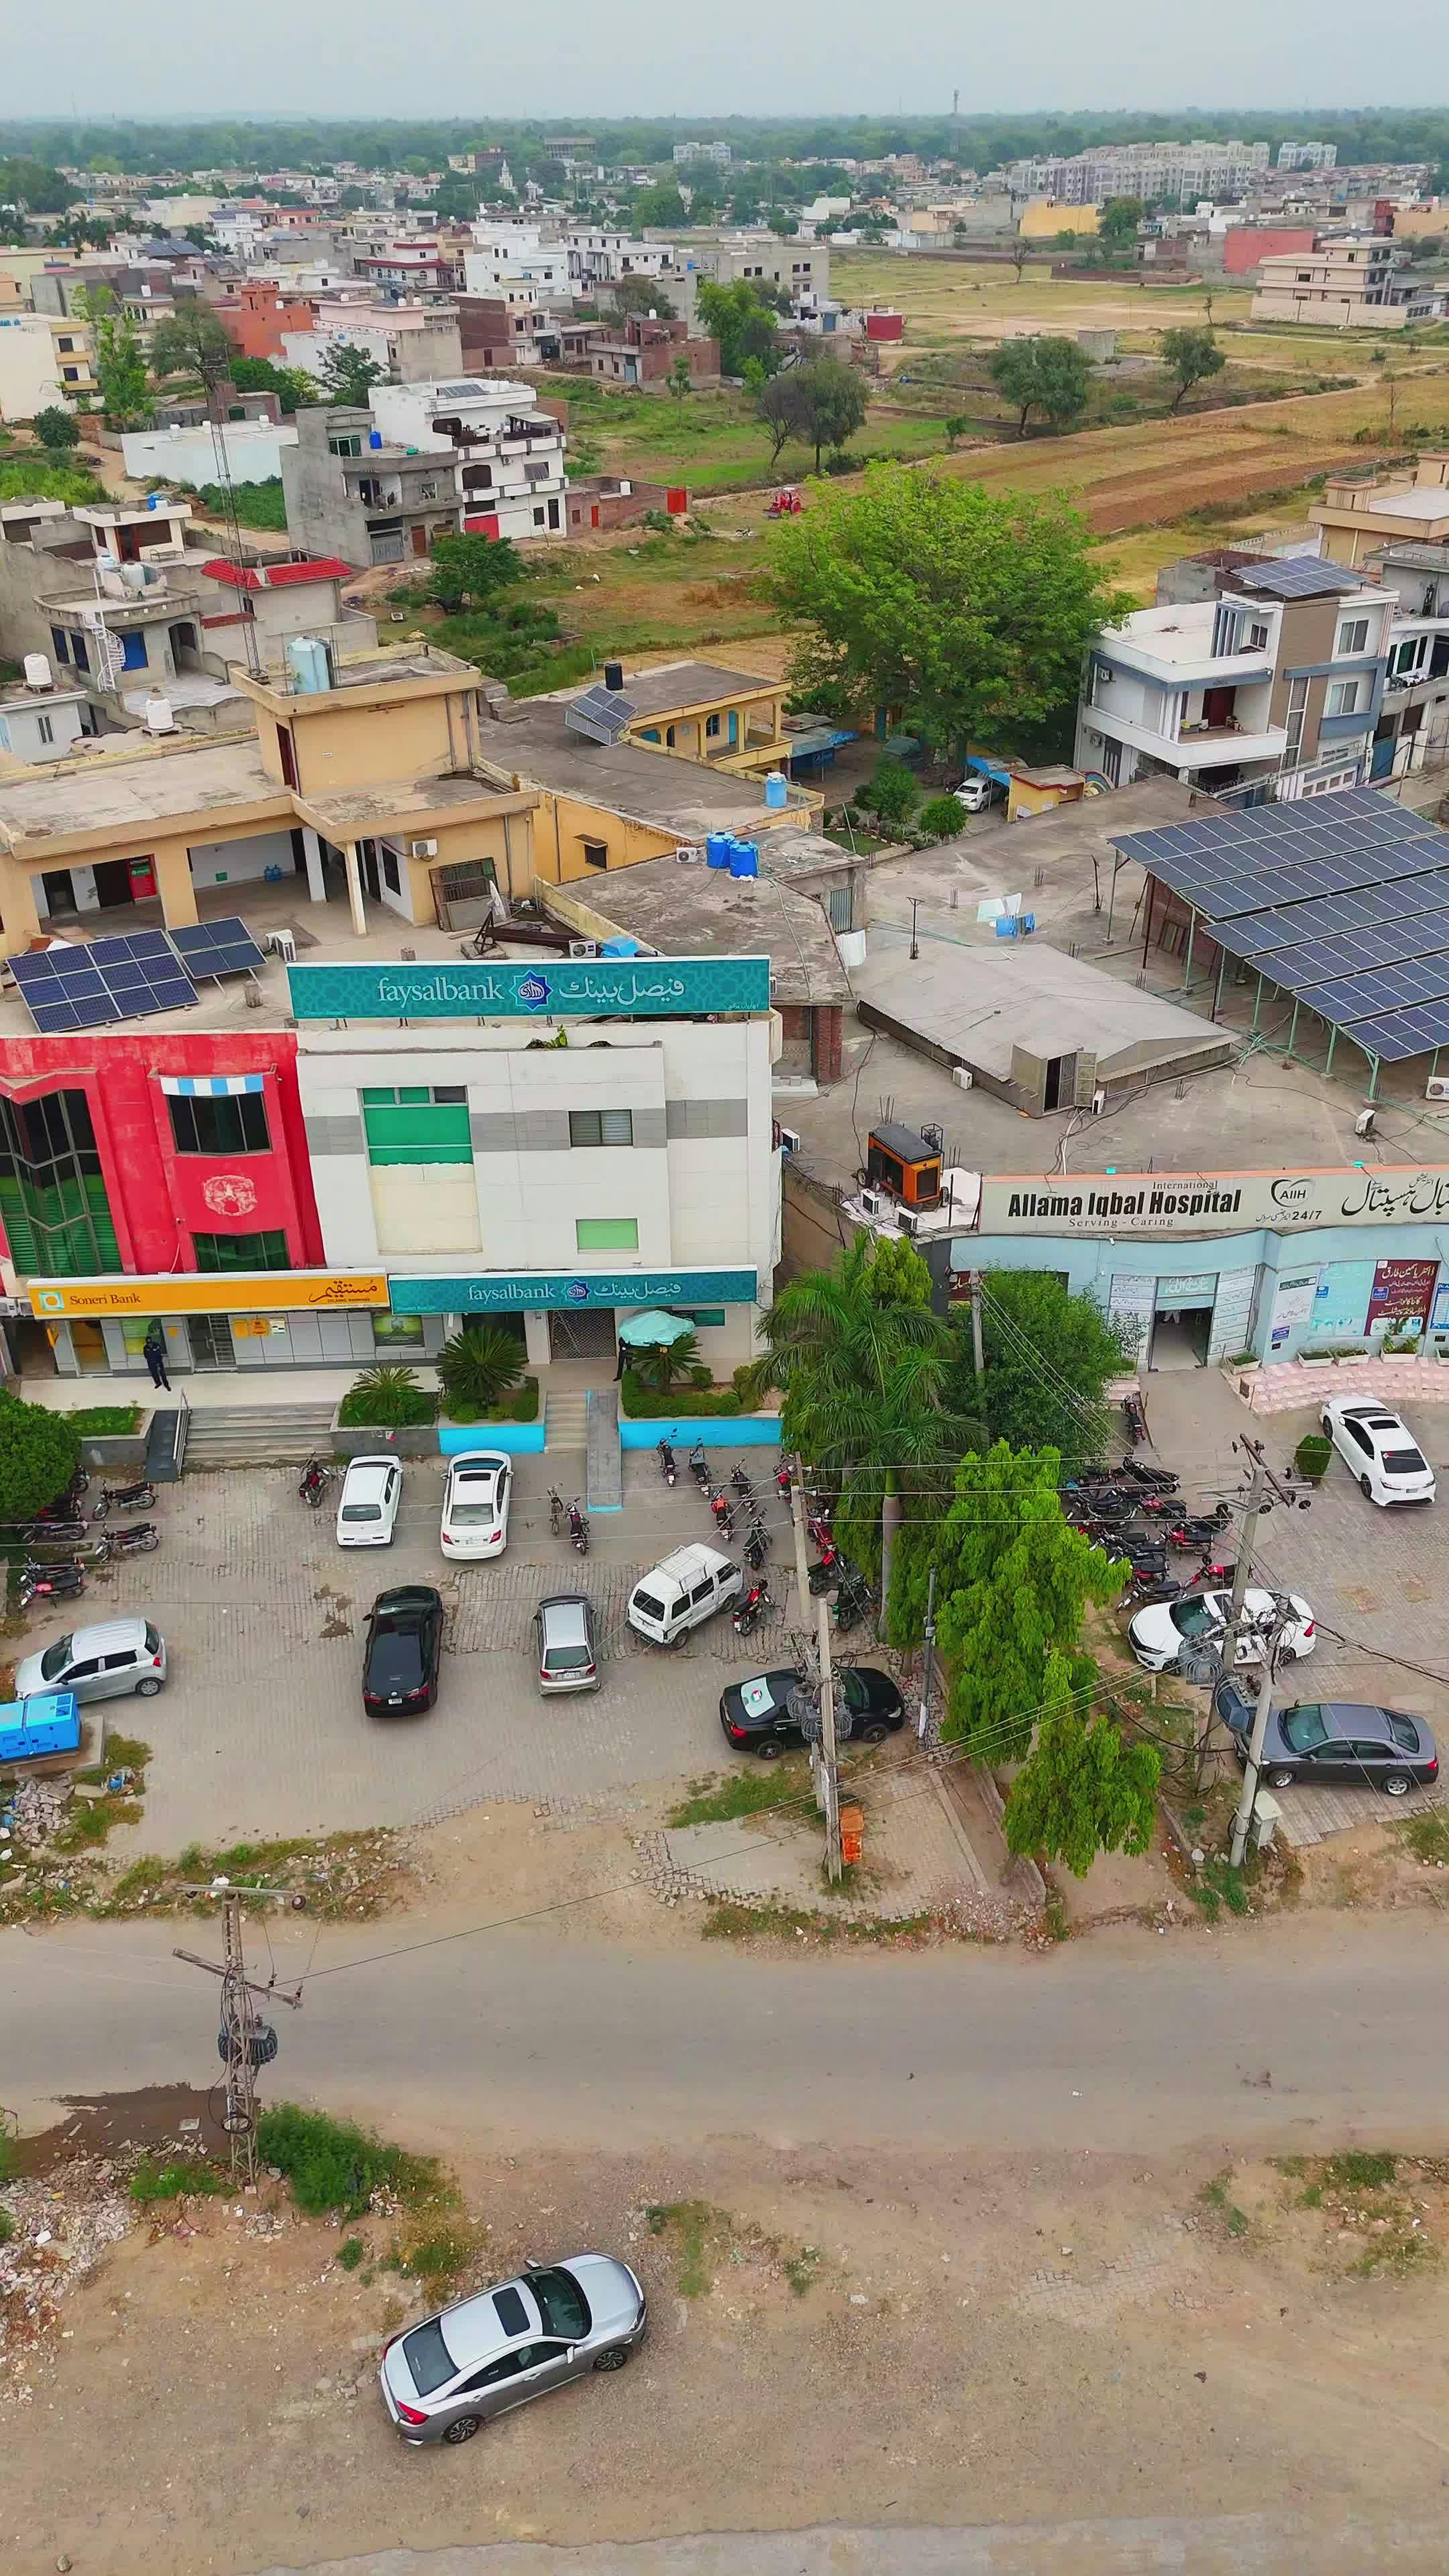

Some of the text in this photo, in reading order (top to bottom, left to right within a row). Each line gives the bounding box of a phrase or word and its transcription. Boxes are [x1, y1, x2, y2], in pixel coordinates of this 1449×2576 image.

[377, 977, 504, 1008] faysalbank
[1152, 1180, 1218, 1190] International
[1008, 1189, 1242, 1217] Allama Iqbal Hospital
[1291, 1210, 1322, 1220] 24/7
[1069, 1218, 1118, 1228] Serving
[1130, 1217, 1174, 1227] Caring
[70, 1293, 141, 1305] Soneri Bank
[468, 1283, 555, 1304] faysalbank
